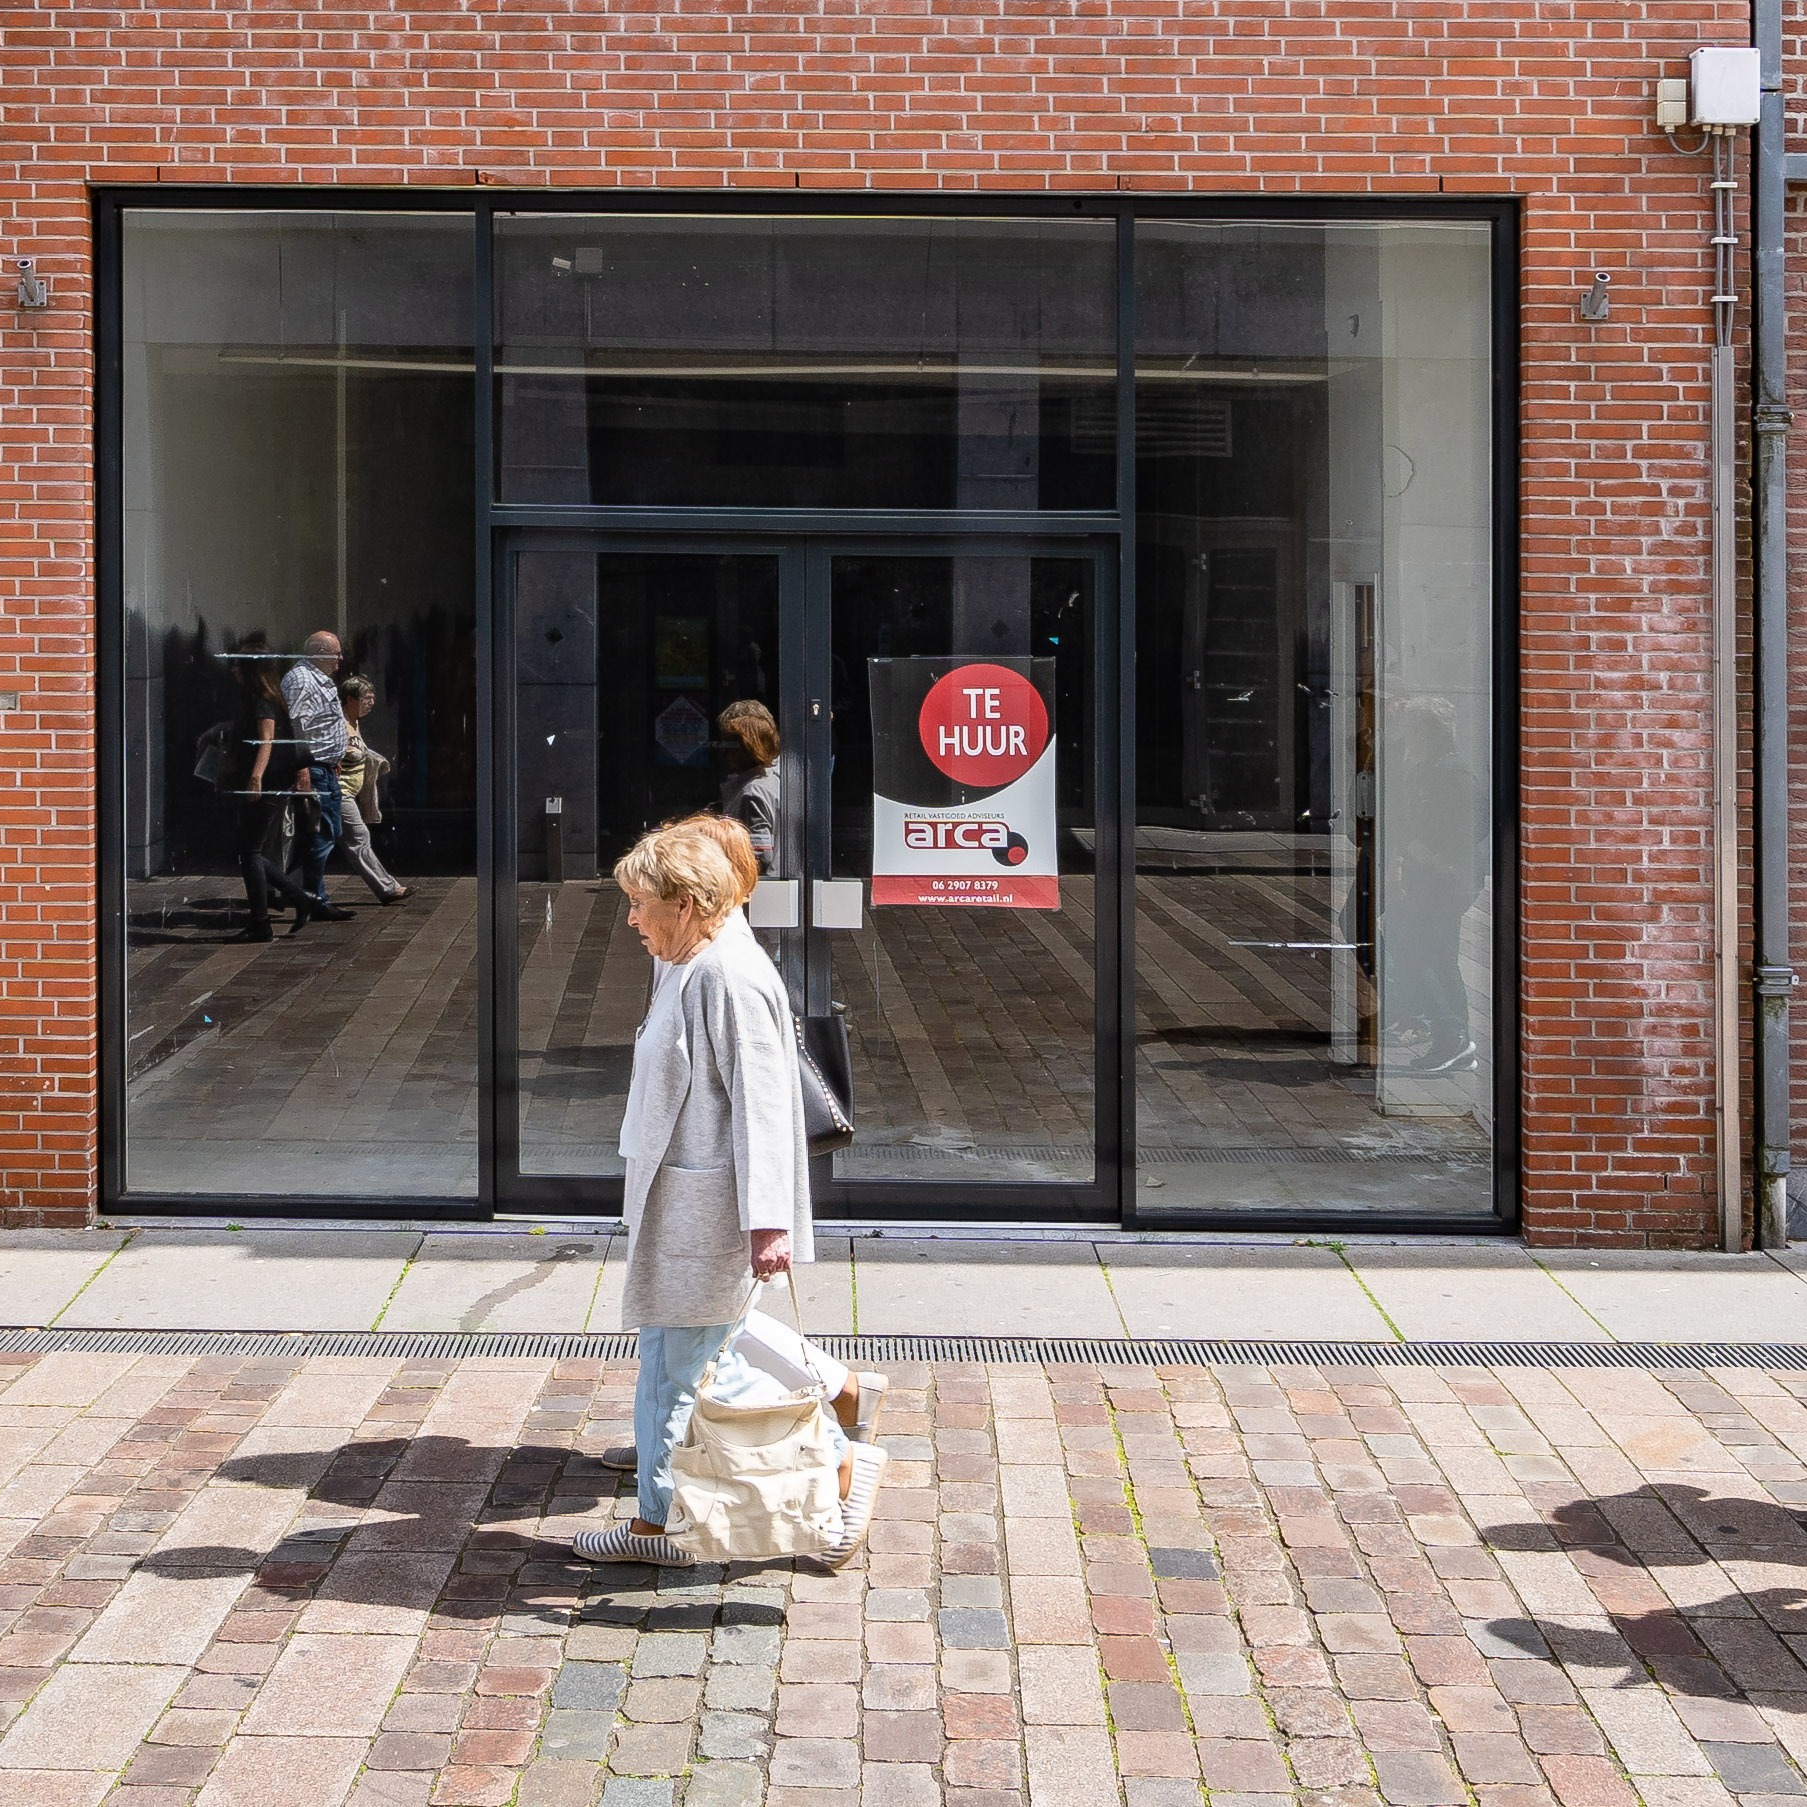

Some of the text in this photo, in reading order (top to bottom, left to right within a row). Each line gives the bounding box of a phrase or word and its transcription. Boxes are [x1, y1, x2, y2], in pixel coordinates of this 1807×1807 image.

[962, 687, 1001, 719] TE
[938, 725, 1028, 757] HUUR
[928, 812, 966, 820] VASTGOED
[967, 812, 1005, 820] ADVISEURS
[906, 822, 1008, 848] arca
[932, 880, 999, 891] 06 2907 8379
[917, 894, 1013, 903] www.arcaretail.nl
